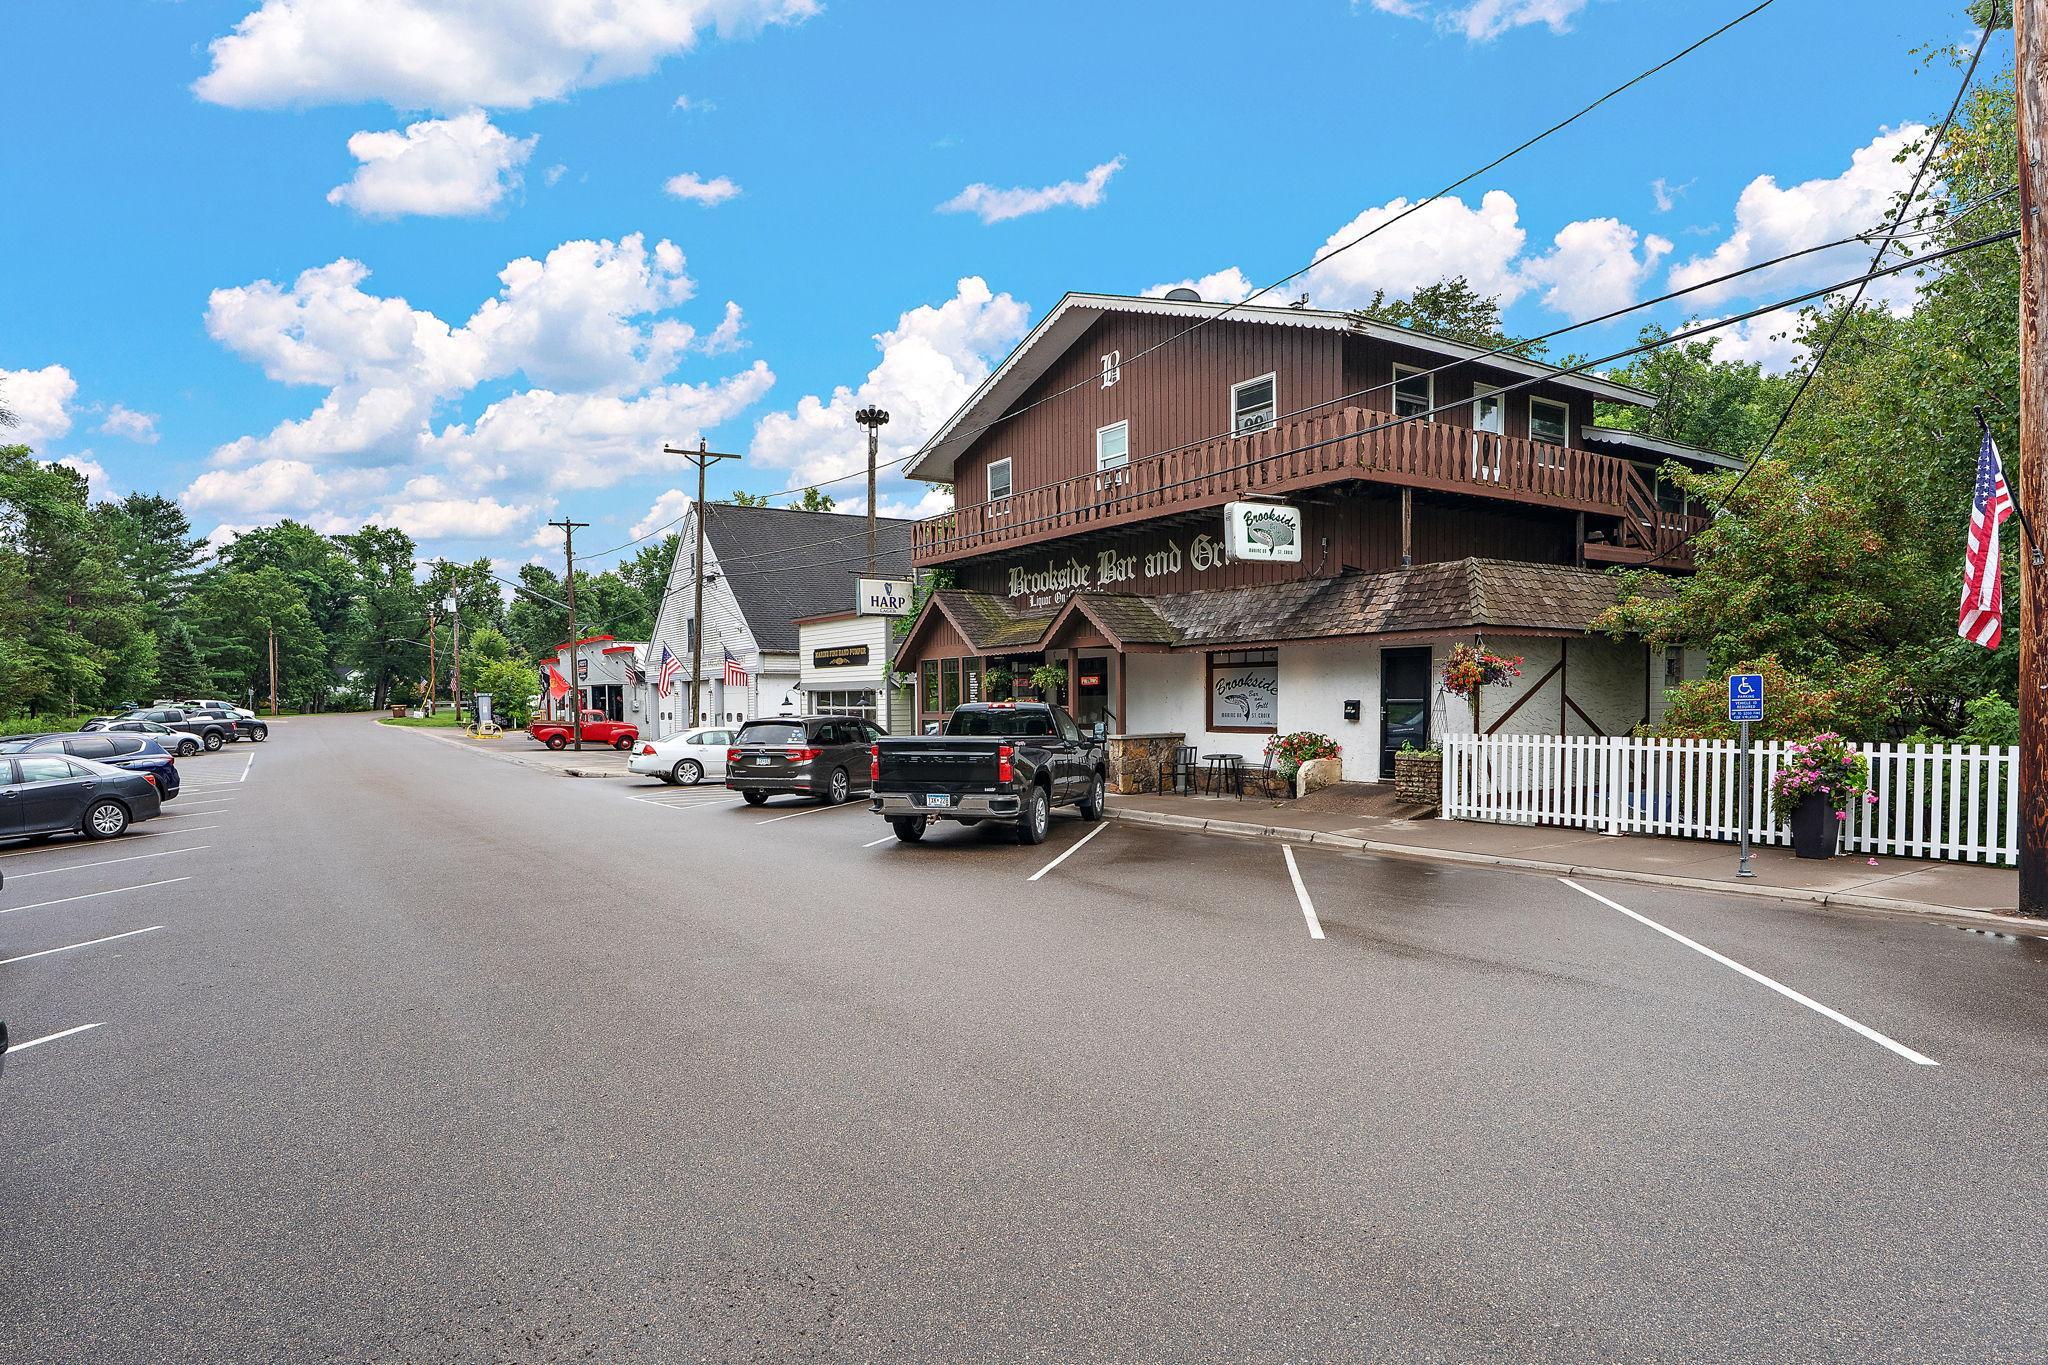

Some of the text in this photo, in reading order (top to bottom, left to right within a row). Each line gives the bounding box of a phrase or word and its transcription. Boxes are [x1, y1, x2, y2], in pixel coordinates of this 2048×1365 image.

[1243, 508, 1296, 530] Brookside
[1008, 556, 1091, 598] Brookside
[1097, 549, 1137, 586] Bar
[1144, 539, 1181, 578] and
[871, 595, 905, 609] HARP
[1029, 595, 1051, 608] Liquor
[1215, 672, 1278, 695] Brookside
